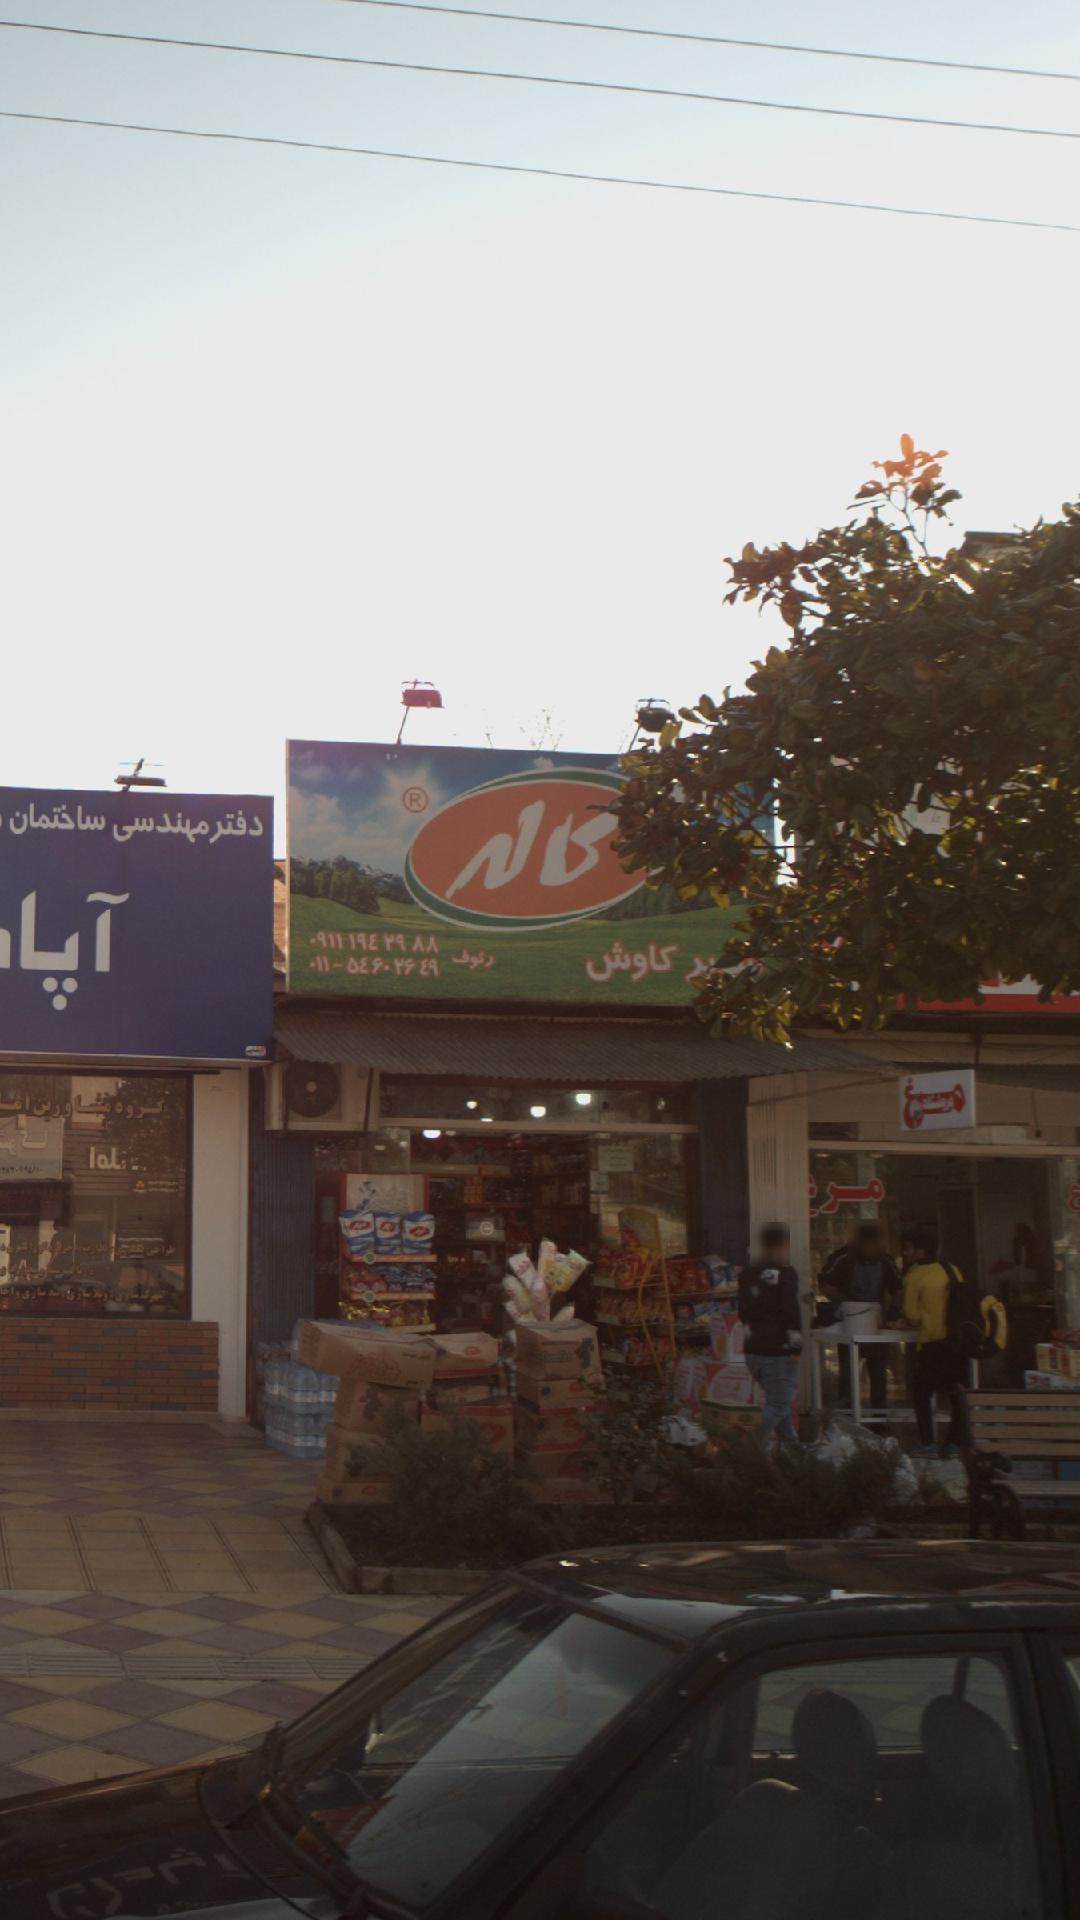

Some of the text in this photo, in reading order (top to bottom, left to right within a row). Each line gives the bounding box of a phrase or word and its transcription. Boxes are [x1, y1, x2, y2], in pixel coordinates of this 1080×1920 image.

[9, 803, 264, 844] دفتر مهندسی ساختمان
[585, 938, 679, 982] کاوش
